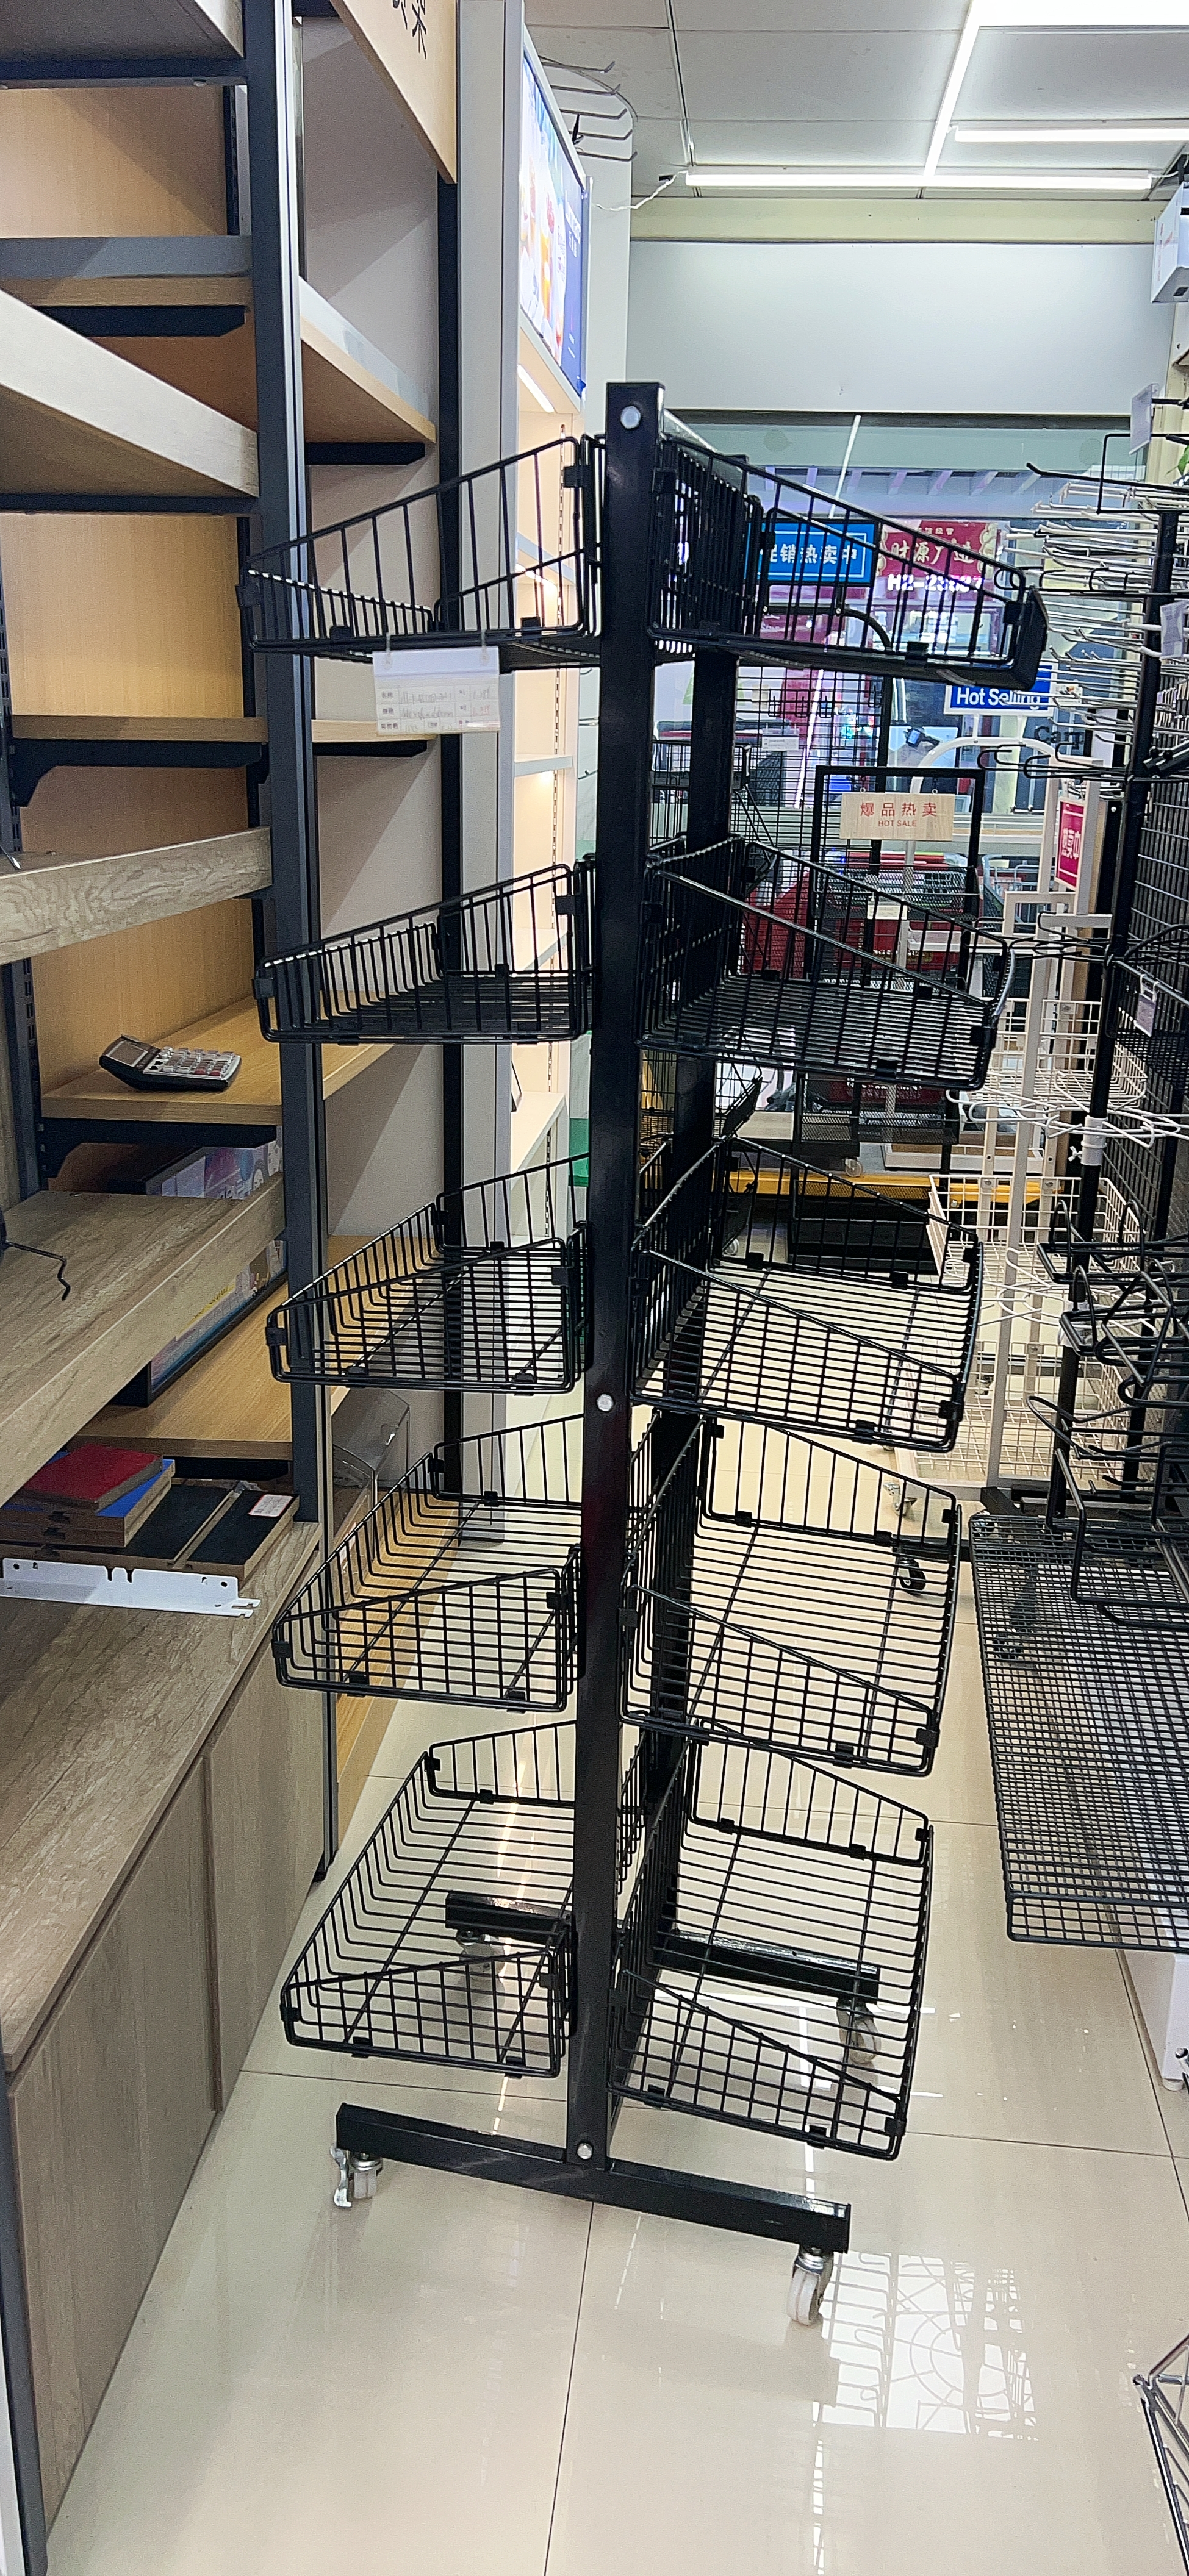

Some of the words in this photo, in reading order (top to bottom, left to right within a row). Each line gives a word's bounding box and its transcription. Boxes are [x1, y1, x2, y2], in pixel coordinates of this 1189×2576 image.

[956, 687, 986, 706] Hot
[988, 688, 1041, 710] Selling
[860, 802, 937, 817] 爆品热卖
